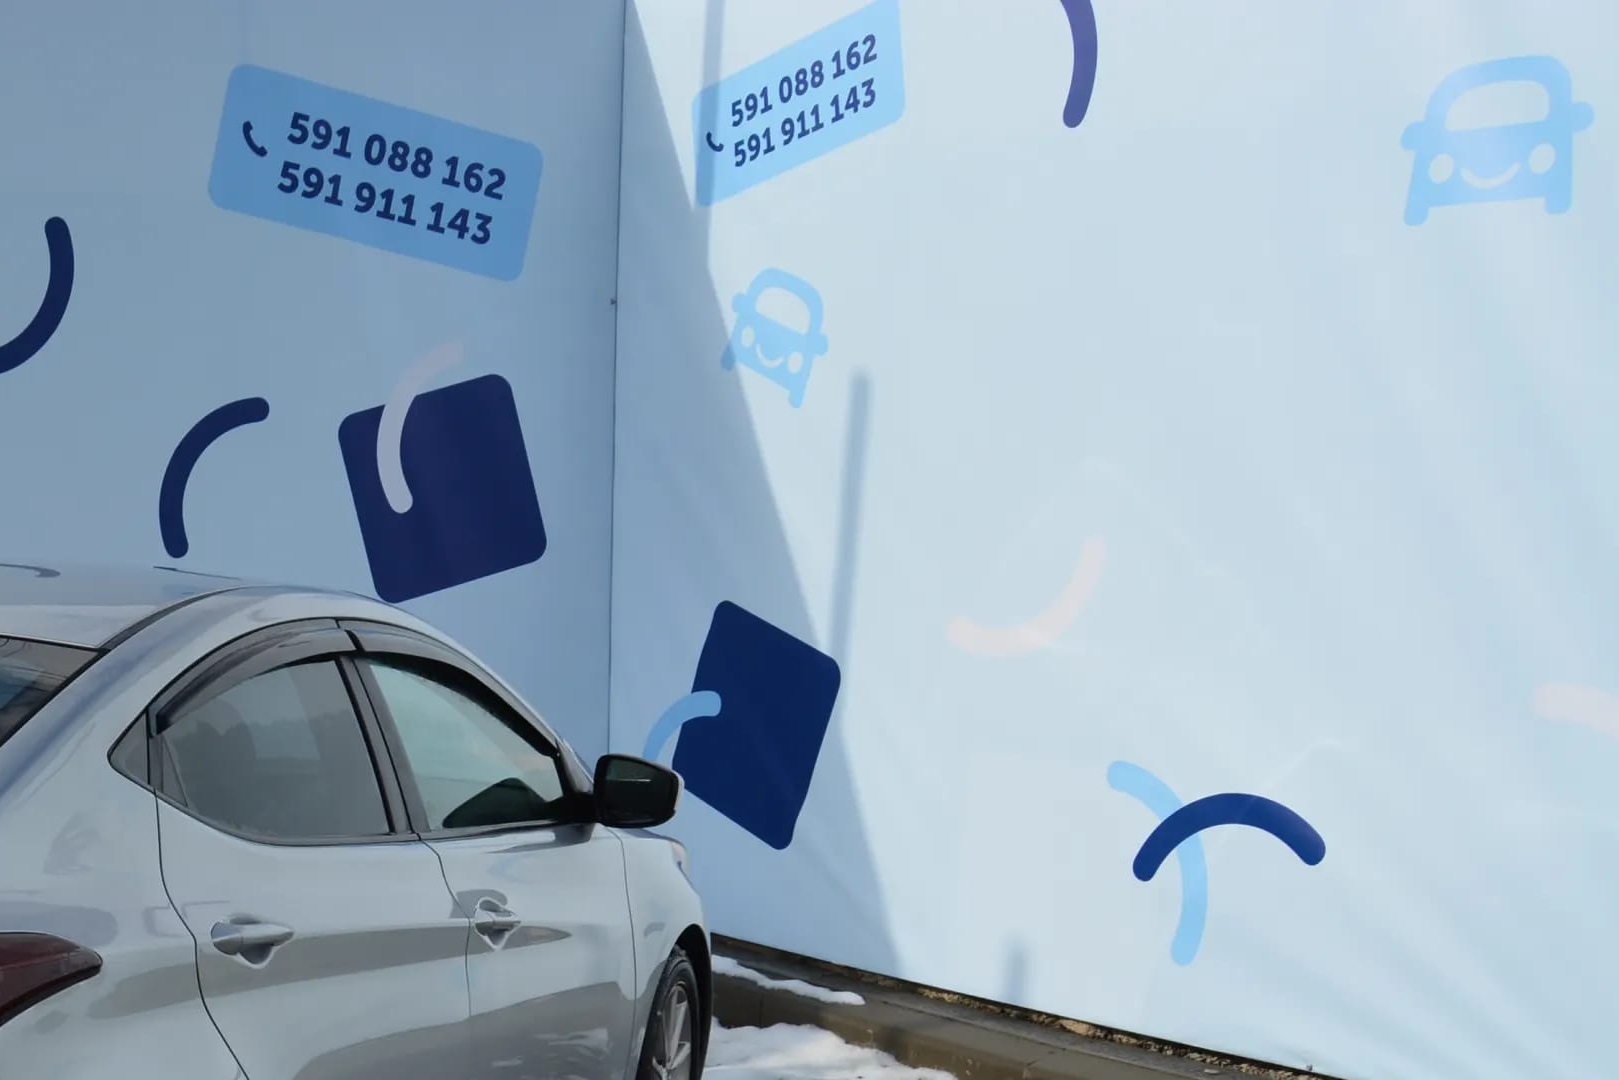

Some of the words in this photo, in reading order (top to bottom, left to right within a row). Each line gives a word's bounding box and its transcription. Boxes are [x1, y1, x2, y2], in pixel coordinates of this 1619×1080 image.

[732, 86, 773, 127] 591
[779, 60, 824, 103] 088
[831, 34, 878, 79] 162
[734, 127, 776, 167] 591
[781, 104, 824, 146] 911
[830, 77, 876, 123] 143
[287, 111, 352, 159] 591
[363, 133, 434, 179] 088
[441, 156, 506, 200] 162
[277, 160, 343, 206] 591
[353, 182, 417, 226] 911
[426, 202, 493, 245] 143
